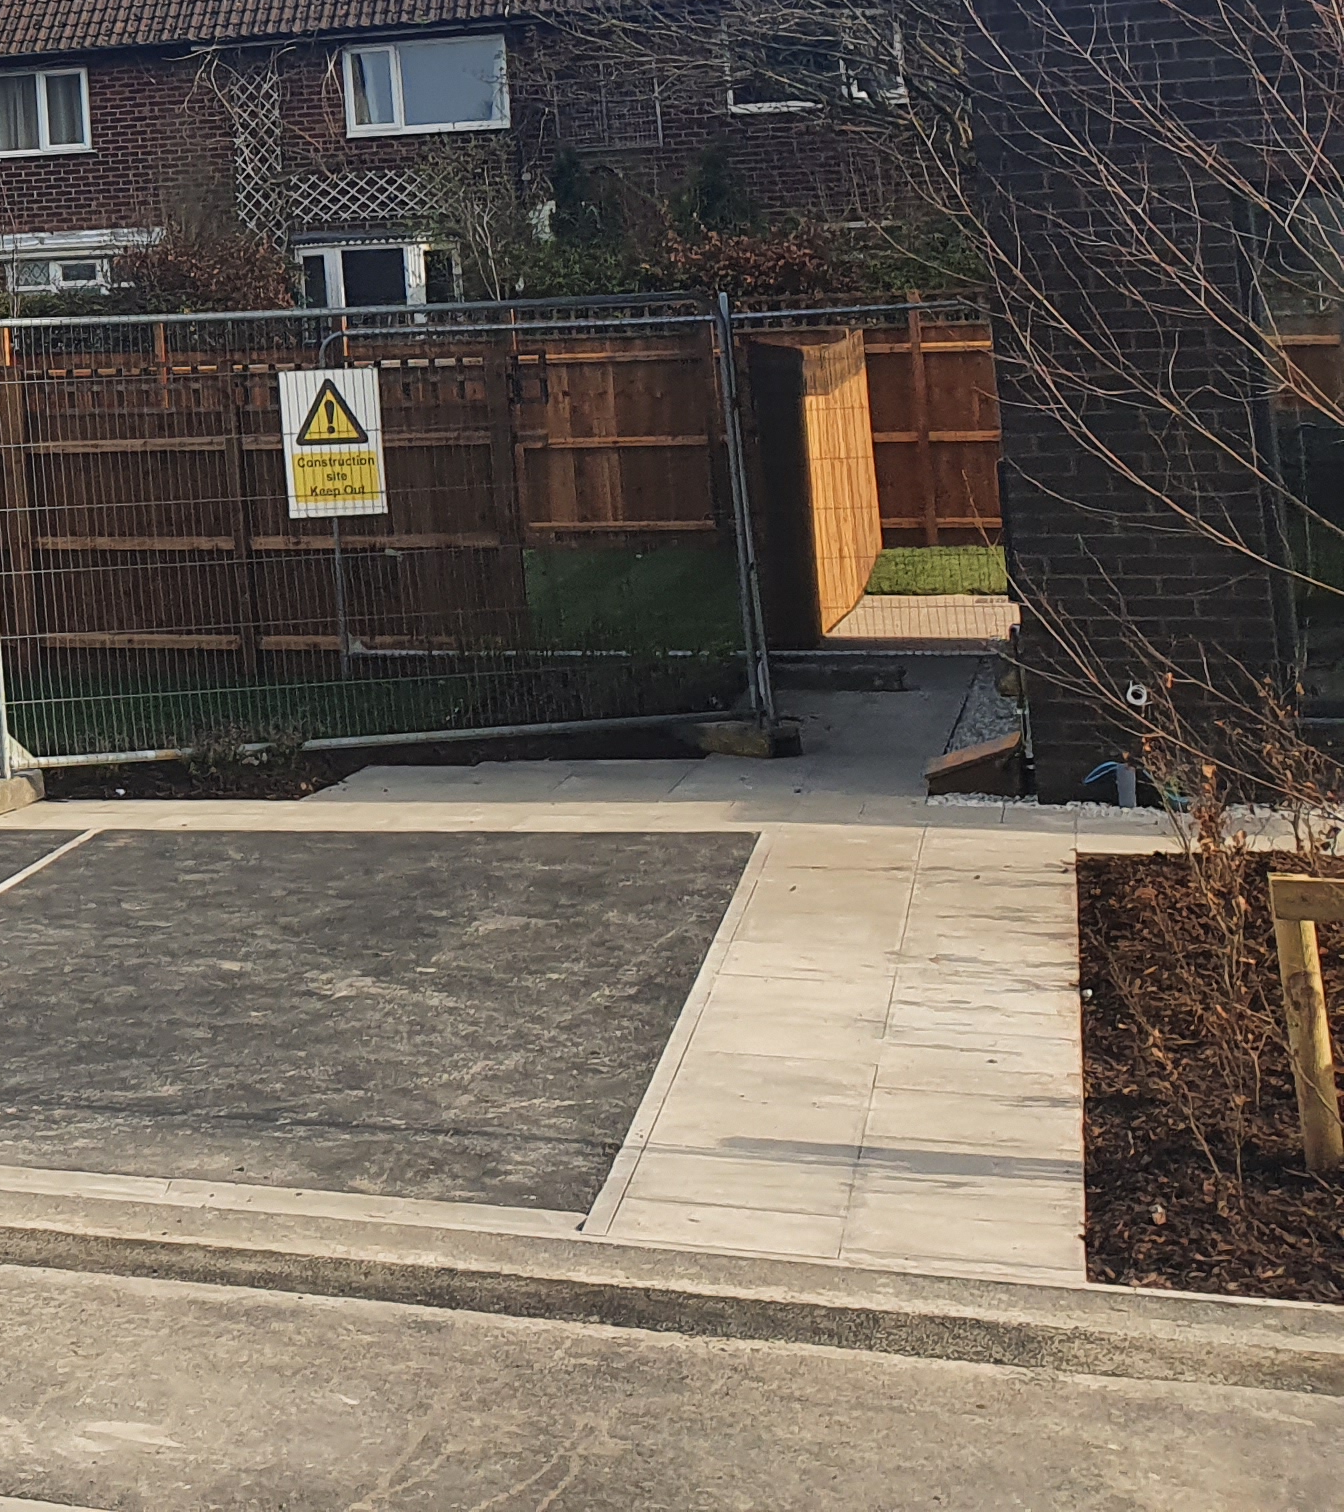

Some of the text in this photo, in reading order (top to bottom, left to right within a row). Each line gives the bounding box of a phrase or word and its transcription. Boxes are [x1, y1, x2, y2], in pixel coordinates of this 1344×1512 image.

[297, 455, 375, 468] Construction
[326, 472, 348, 481] site
[310, 484, 365, 498] Keep Out
